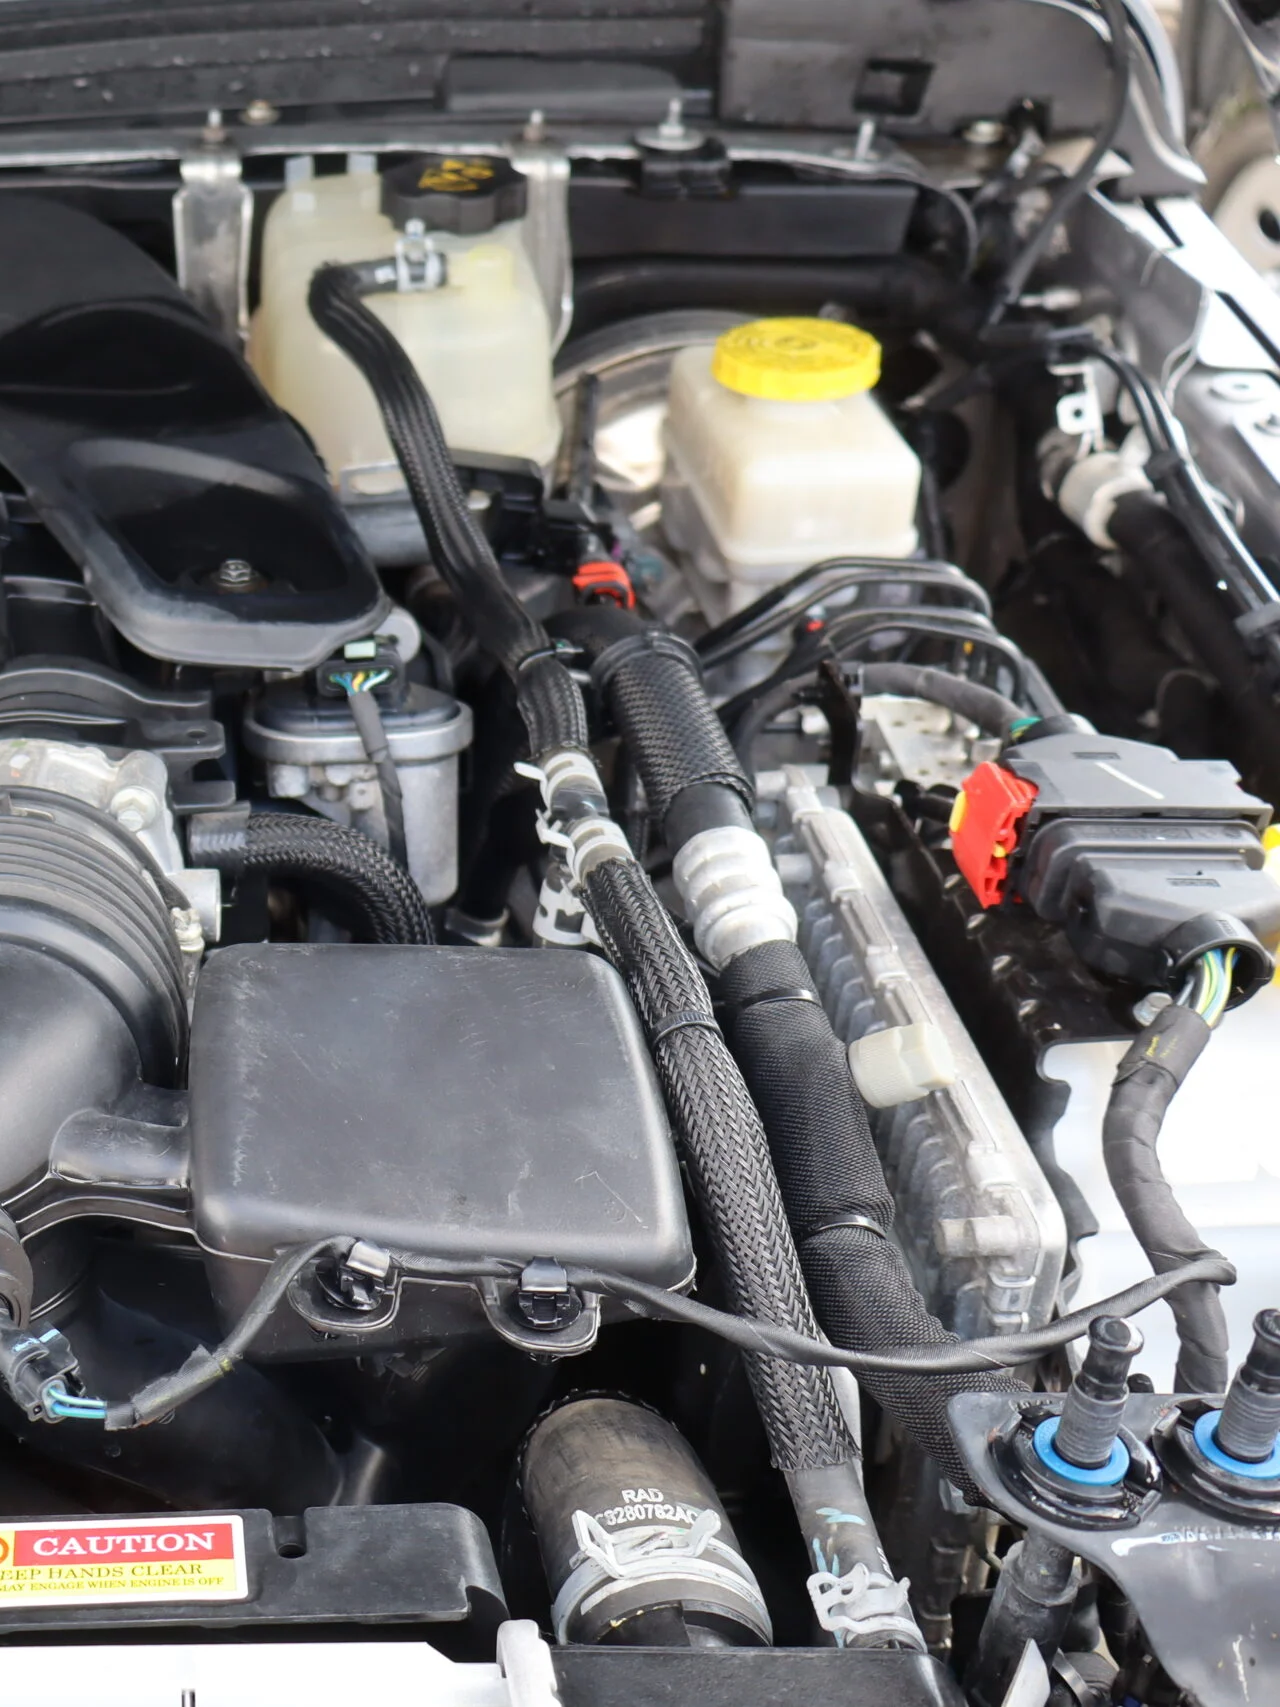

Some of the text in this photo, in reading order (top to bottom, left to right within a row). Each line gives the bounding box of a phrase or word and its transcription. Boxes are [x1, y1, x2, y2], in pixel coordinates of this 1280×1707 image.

[622, 1488, 664, 1503] RAD
[33, 1532, 215, 1556] CAUTION
[48, 1565, 124, 1580] HANDS
[131, 1563, 203, 1577] CLEAR
[30, 1581, 85, 1591] ENGAGE
[87, 1580, 127, 1590] WHEN
[130, 1578, 179, 1588] ENGINE
[183, 1577, 196, 1587] IS
[198, 1576, 225, 1586] OFF
